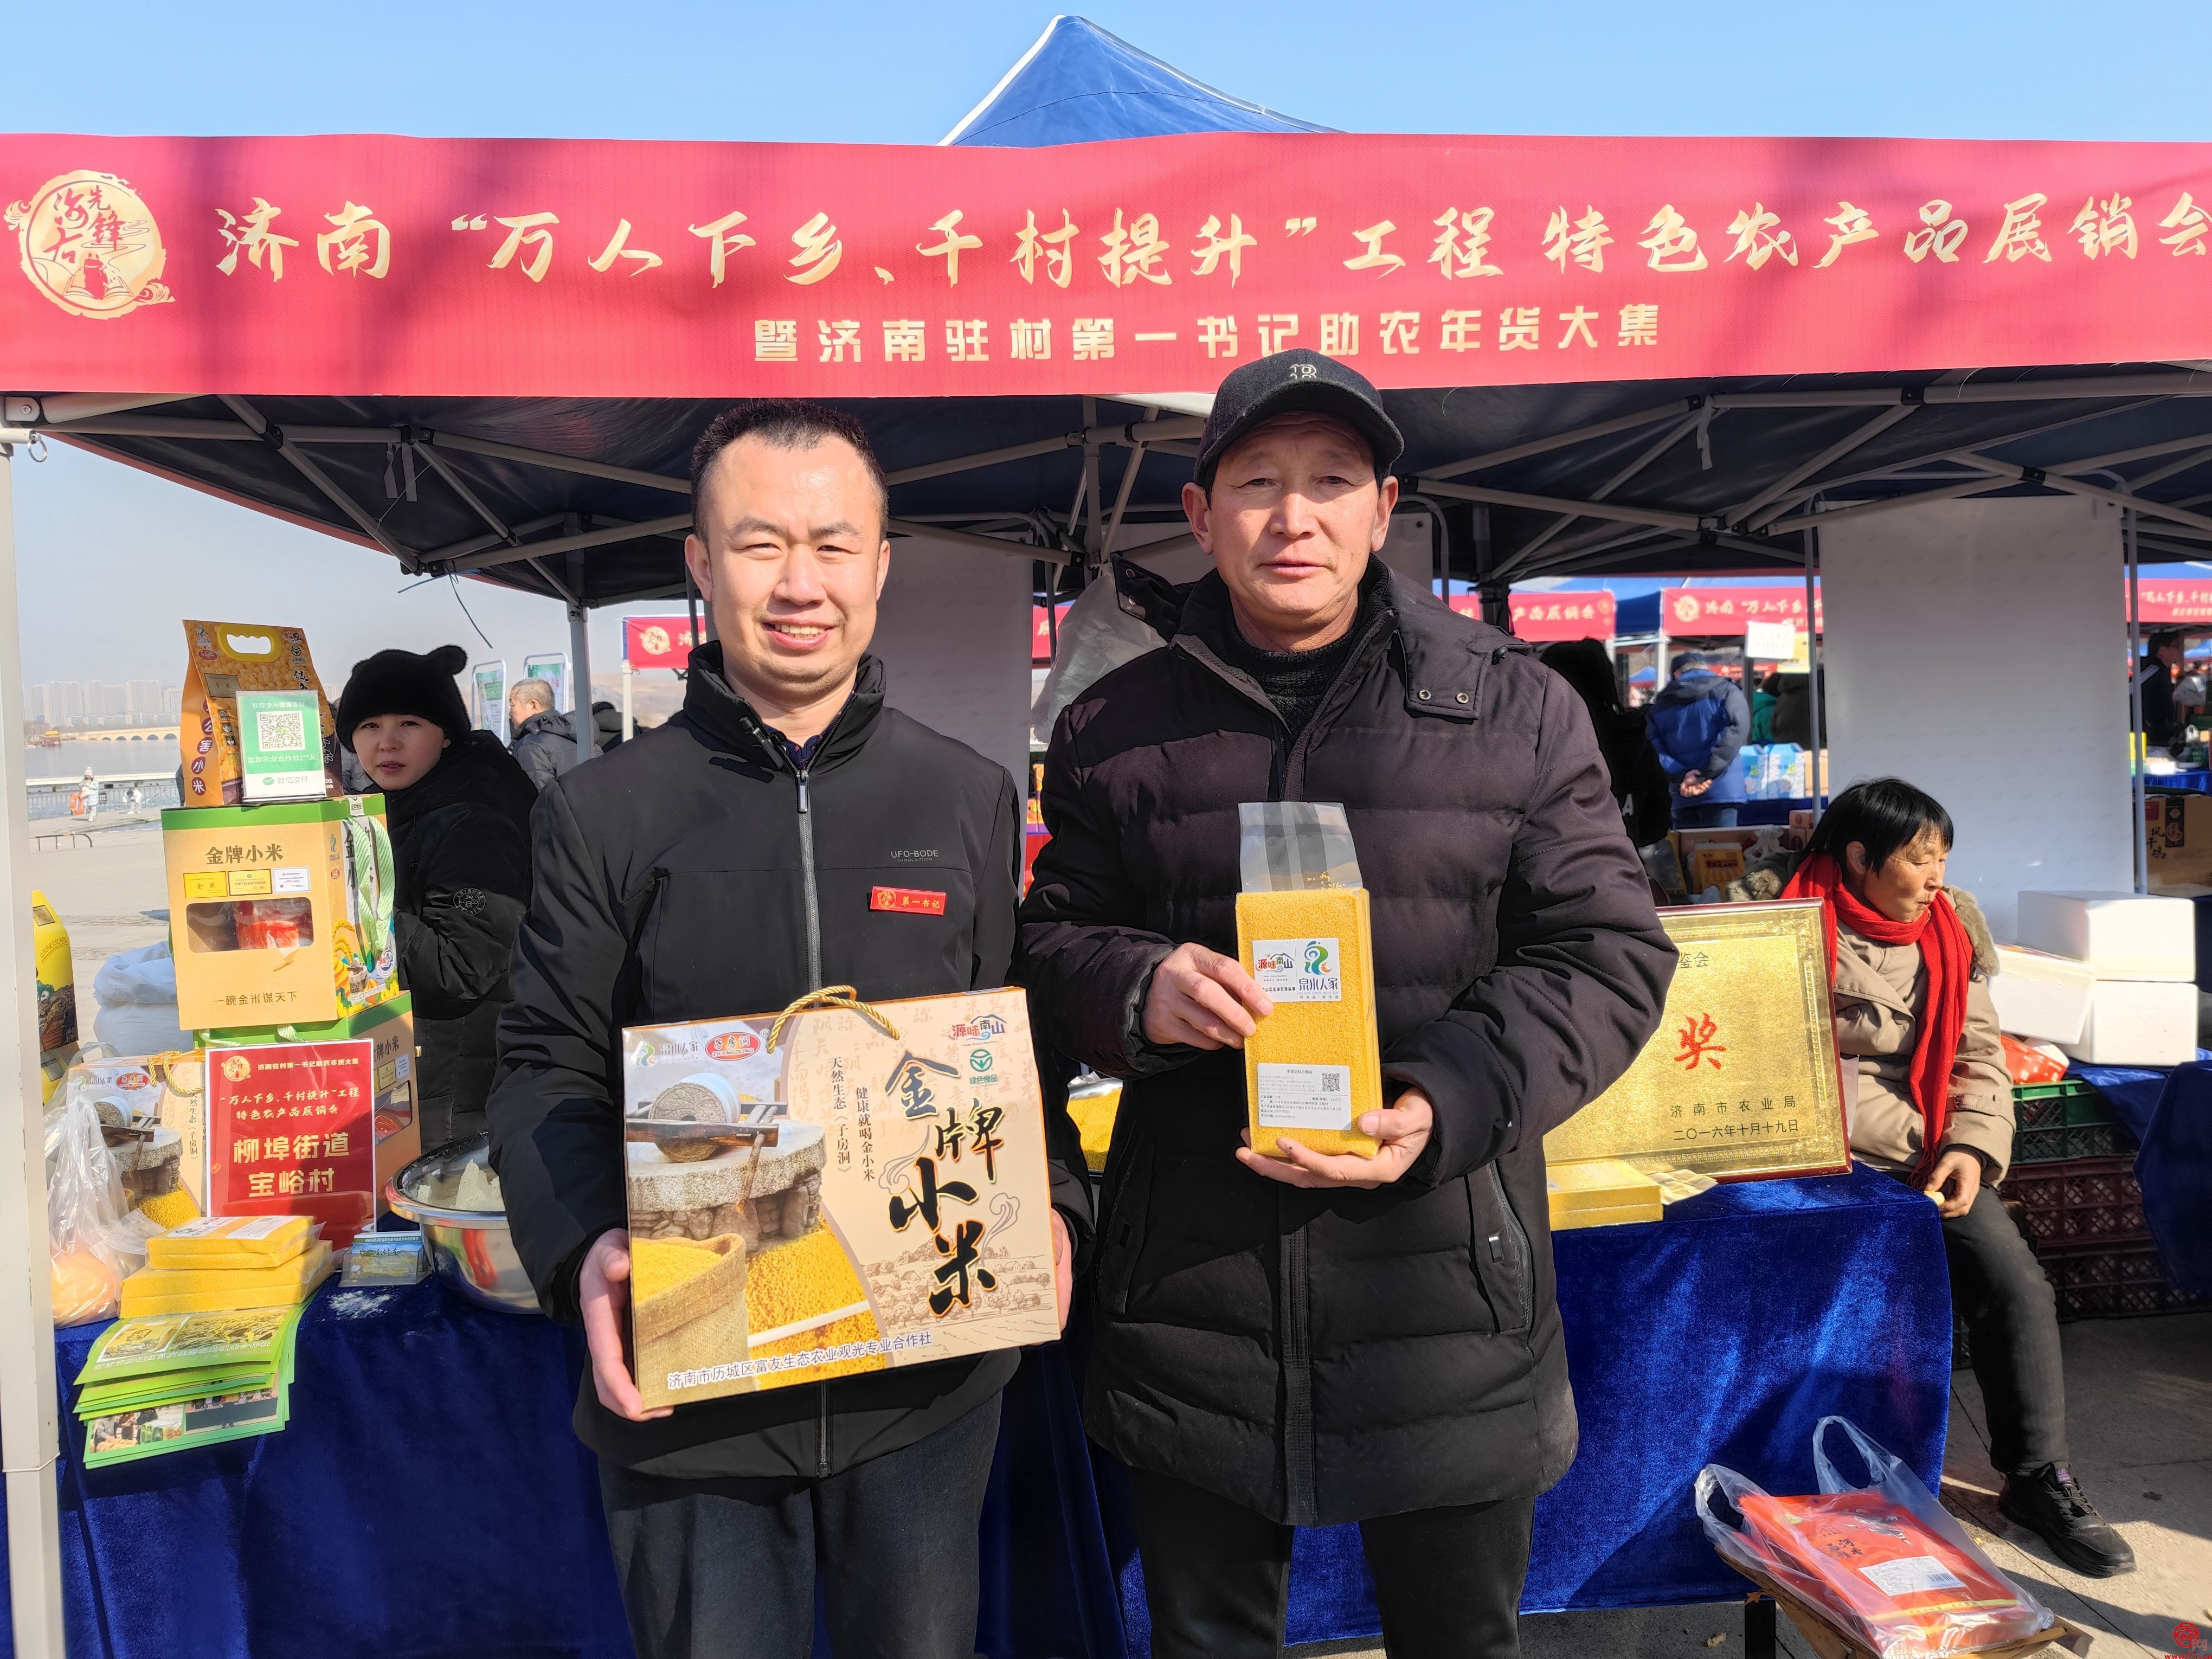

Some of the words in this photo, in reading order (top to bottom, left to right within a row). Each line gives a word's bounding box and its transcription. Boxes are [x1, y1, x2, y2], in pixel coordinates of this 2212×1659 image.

[754, 304, 1659, 362] 暨济南驻村第一书记助农年货大集
[276, 776, 308, 784] 微信支付
[204, 843, 284, 865] 金牌小米
[890, 850, 939, 858] UFO-BODE
[901, 896, 941, 909] 第一书记
[1258, 957, 1293, 970] 源味南山
[1299, 977, 1338, 991] 泉水人家
[213, 991, 298, 1006] 一碗金米谋天下
[952, 1019, 1006, 1038] 源味南山
[374, 1036, 400, 1063] 牌小米
[1674, 1012, 1727, 1071] 奖
[711, 1048, 754, 1057] ZIFANGDONG
[257, 1058, 359, 1071] 济南驻村第一书记助农年货大集
[969, 1074, 999, 1085] 绿色食品
[235, 1104, 339, 1121] 特色农产品展销会
[1670, 1095, 1797, 1118] 济南市农业局
[856, 1086, 876, 1182] 健康就喝金小米
[233, 1131, 350, 1165] 柳埠街道
[248, 1167, 335, 1198] 宝峪村
[884, 1050, 1006, 1316] 金牌小米
[667, 1330, 933, 1390] 济南市历城区富友生态农业观光专业合作社
